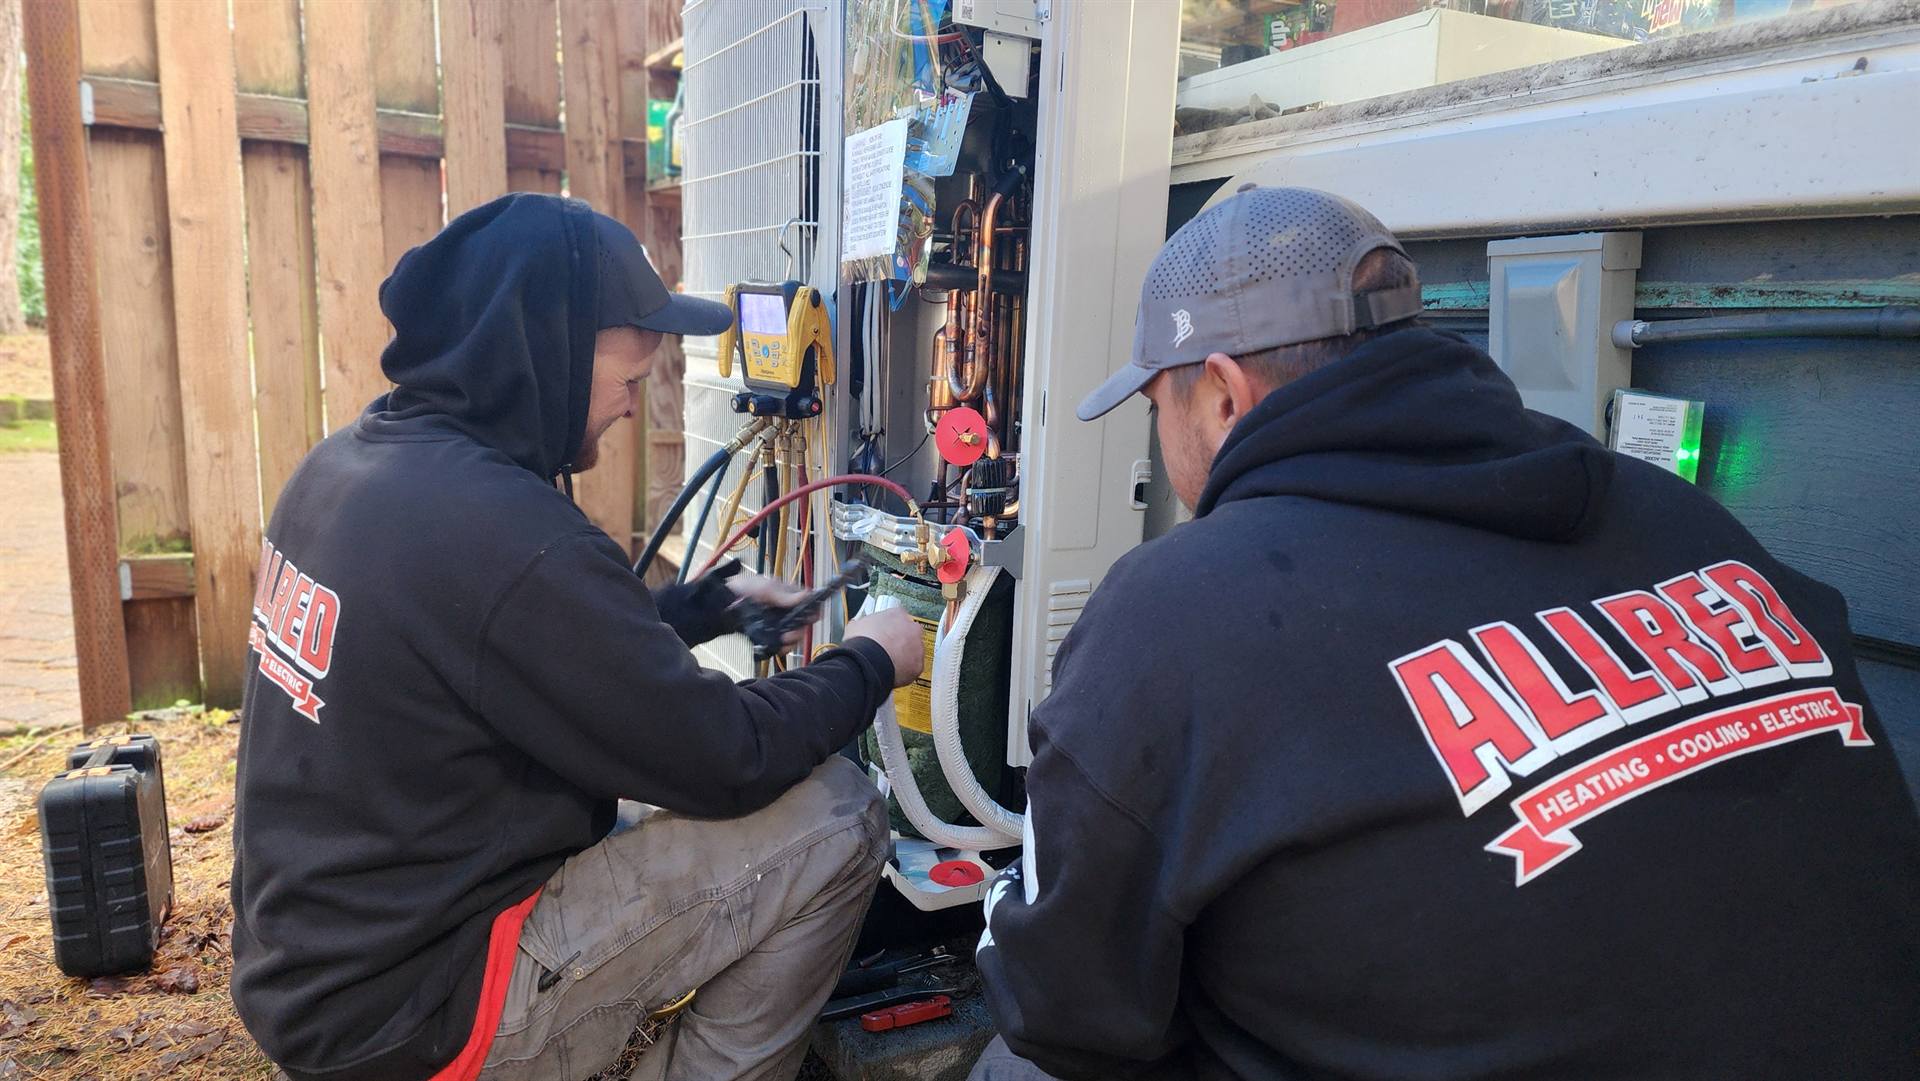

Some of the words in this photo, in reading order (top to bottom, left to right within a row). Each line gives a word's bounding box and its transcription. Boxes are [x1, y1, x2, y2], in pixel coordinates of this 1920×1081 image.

[1314, 3, 1327, 18] 12
[253, 536, 341, 680] LLRED
[269, 659, 303, 693] ELECTRIC
[1388, 559, 1833, 817] ALLRED
[1537, 757, 1650, 823] HEATING
[1667, 719, 1750, 765] COOLING
[1760, 698, 1839, 734] ELECTRIC
